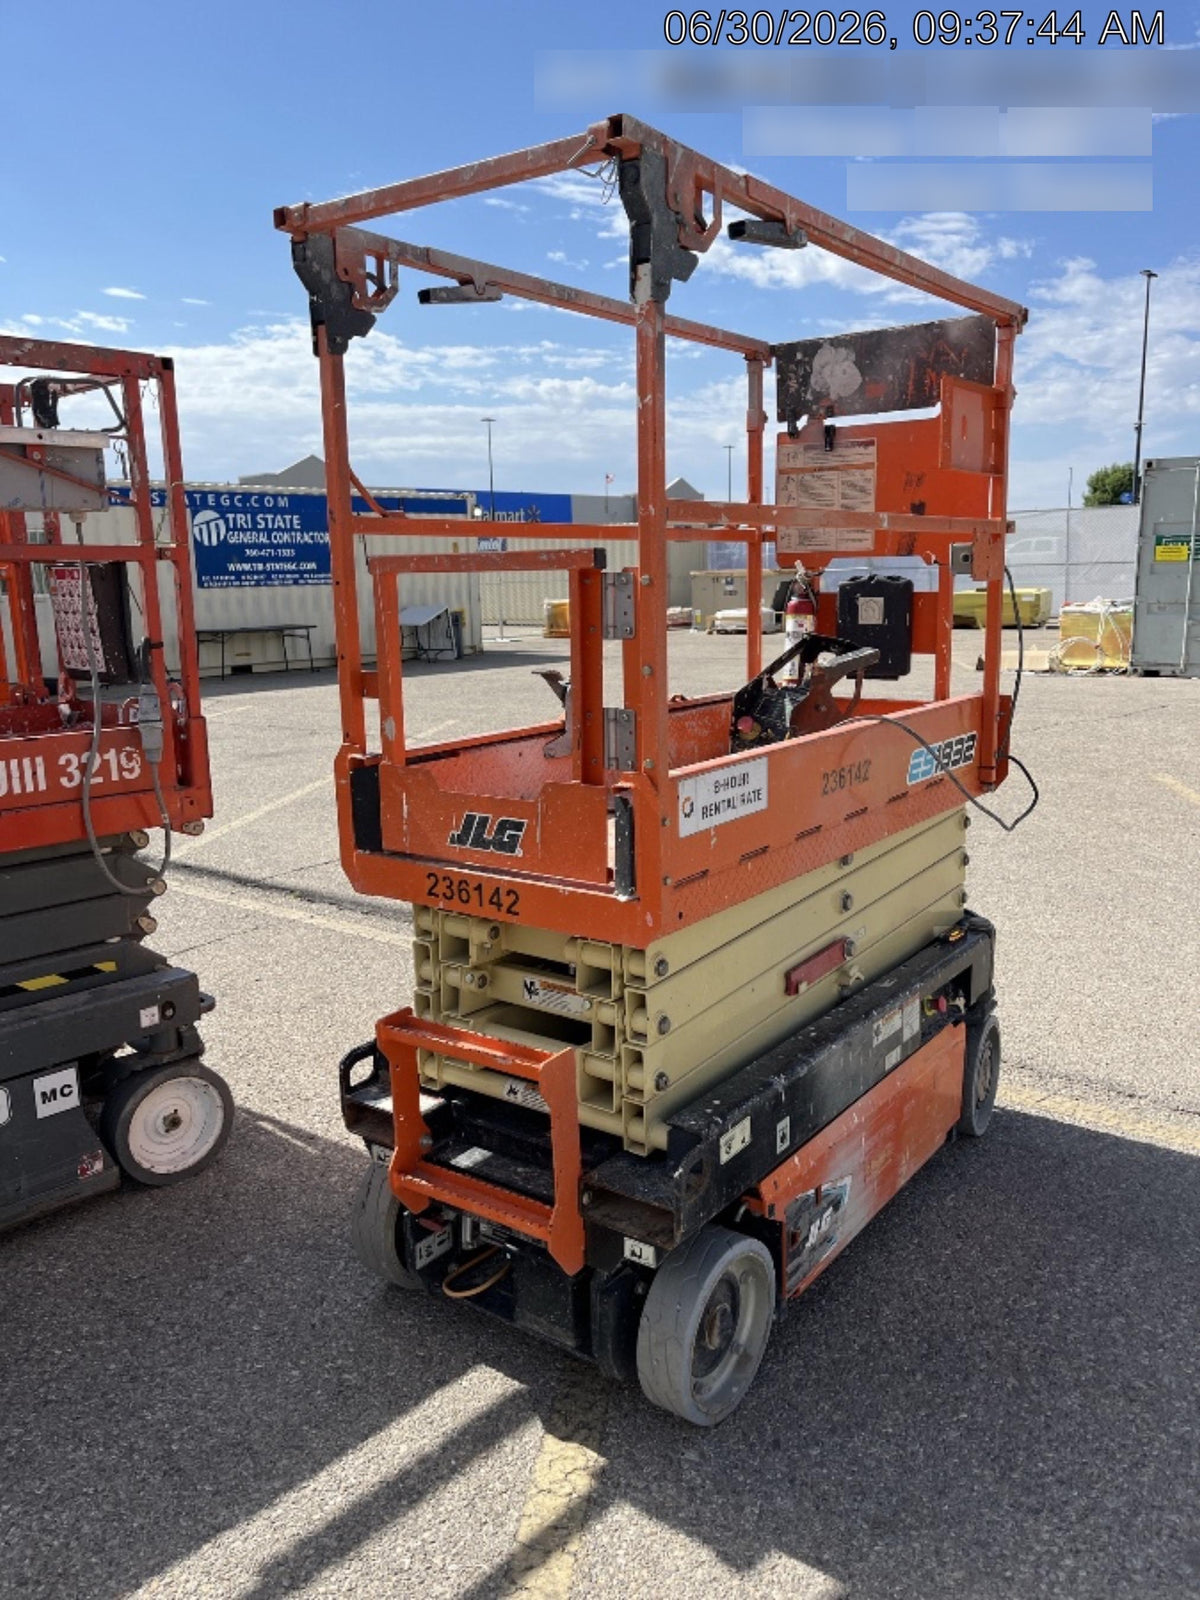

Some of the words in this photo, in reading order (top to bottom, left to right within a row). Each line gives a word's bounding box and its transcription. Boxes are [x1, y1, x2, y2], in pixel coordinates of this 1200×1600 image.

[225, 513, 252, 529] TRI
[256, 514, 301, 529] STATE
[226, 531, 270, 544] GENERAL
[58, 747, 141, 788] 3219
[821, 759, 872, 797] 236142
[701, 796, 736, 819] RENTAL
[739, 788, 762, 805] RATE
[446, 811, 528, 854] JLG
[426, 871, 520, 916] 236142
[40, 1083, 74, 1105] MC
